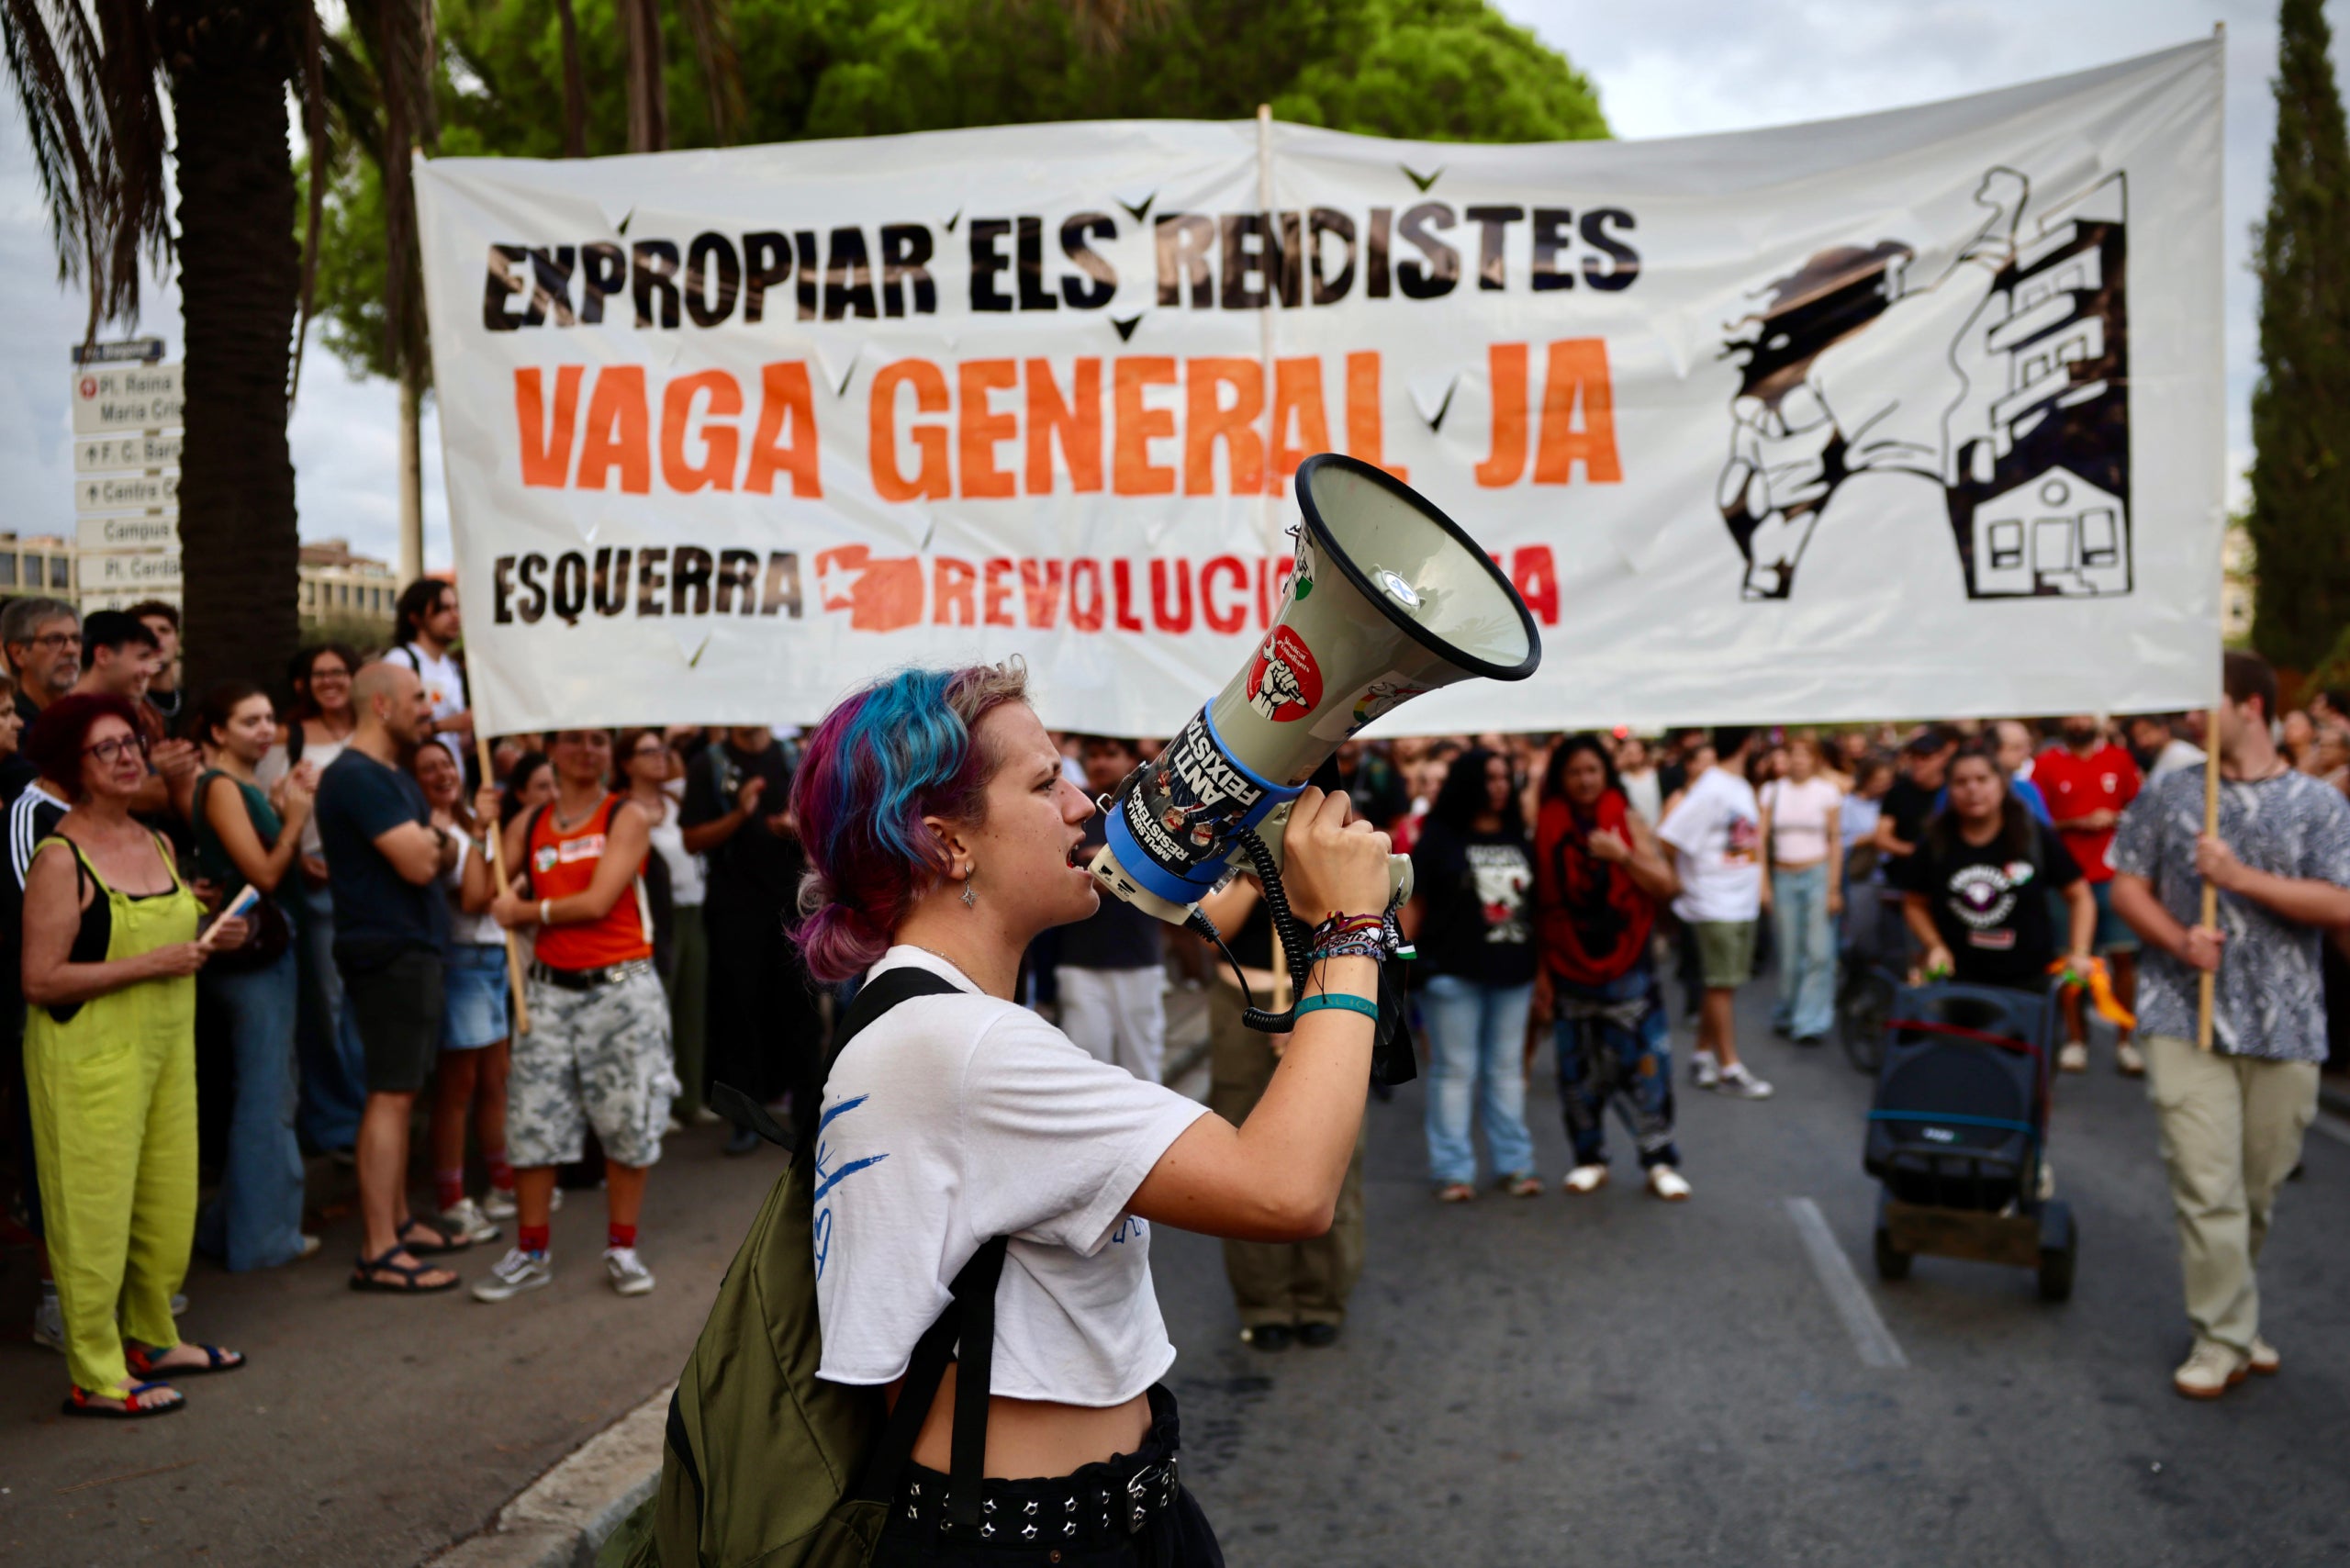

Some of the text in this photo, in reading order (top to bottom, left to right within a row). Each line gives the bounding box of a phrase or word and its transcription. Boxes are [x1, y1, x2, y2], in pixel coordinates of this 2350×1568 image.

[483, 201, 1641, 332] EXPROPIAR ELS RENDISTES
[126, 373, 172, 393] Reina
[100, 398, 184, 423] Maria Cris
[514, 337, 1624, 504] VAGA GENERAL JA
[144, 438, 182, 461] Barc
[103, 479, 157, 504] Centre
[104, 519, 170, 542] Campus
[492, 544, 802, 626] ESQUERRA
[1284, 636, 1306, 661] Sindicat
[1174, 745, 1227, 808] ANTI
[1187, 712, 1262, 807] FEIXISTA
[1130, 812, 1173, 861] IMPULSEM
[1132, 781, 1190, 861] RESISTENCIA
